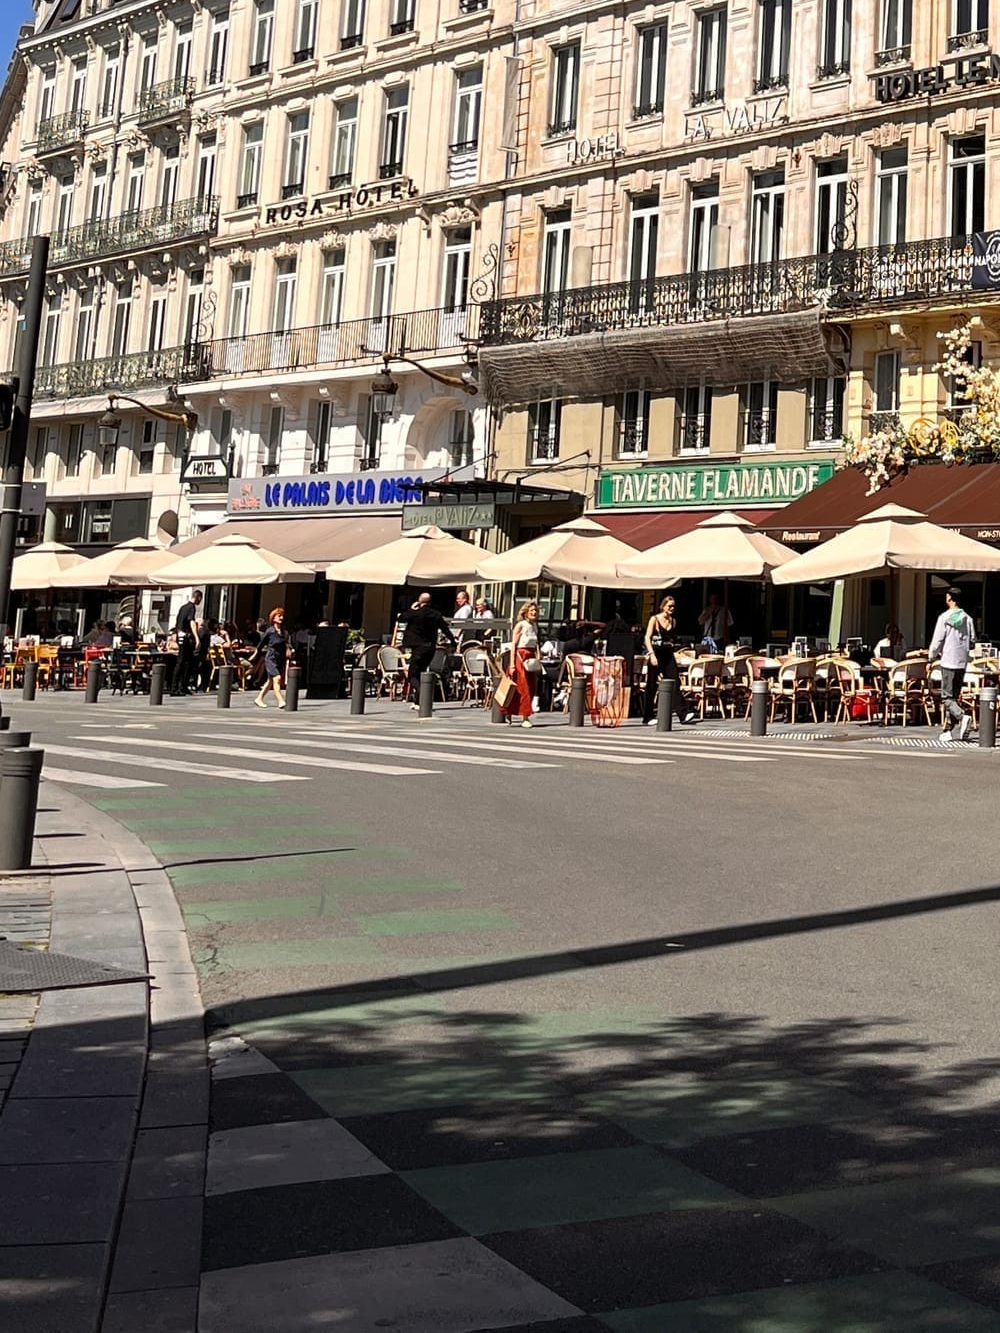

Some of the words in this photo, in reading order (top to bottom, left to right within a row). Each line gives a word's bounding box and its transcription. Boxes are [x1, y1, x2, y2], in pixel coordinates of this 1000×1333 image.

[875, 65, 949, 101] HOTEL
[954, 54, 986, 86] LE
[684, 114, 712, 140] LA
[265, 199, 324, 224] ROSA
[192, 462, 217, 475] HOTEL
[264, 482, 281, 507] LE
[282, 480, 331, 507] PALAIS
[334, 480, 355, 506] DE
[355, 478, 376, 504] LA
[611, 473, 698, 503] TAVERNE
